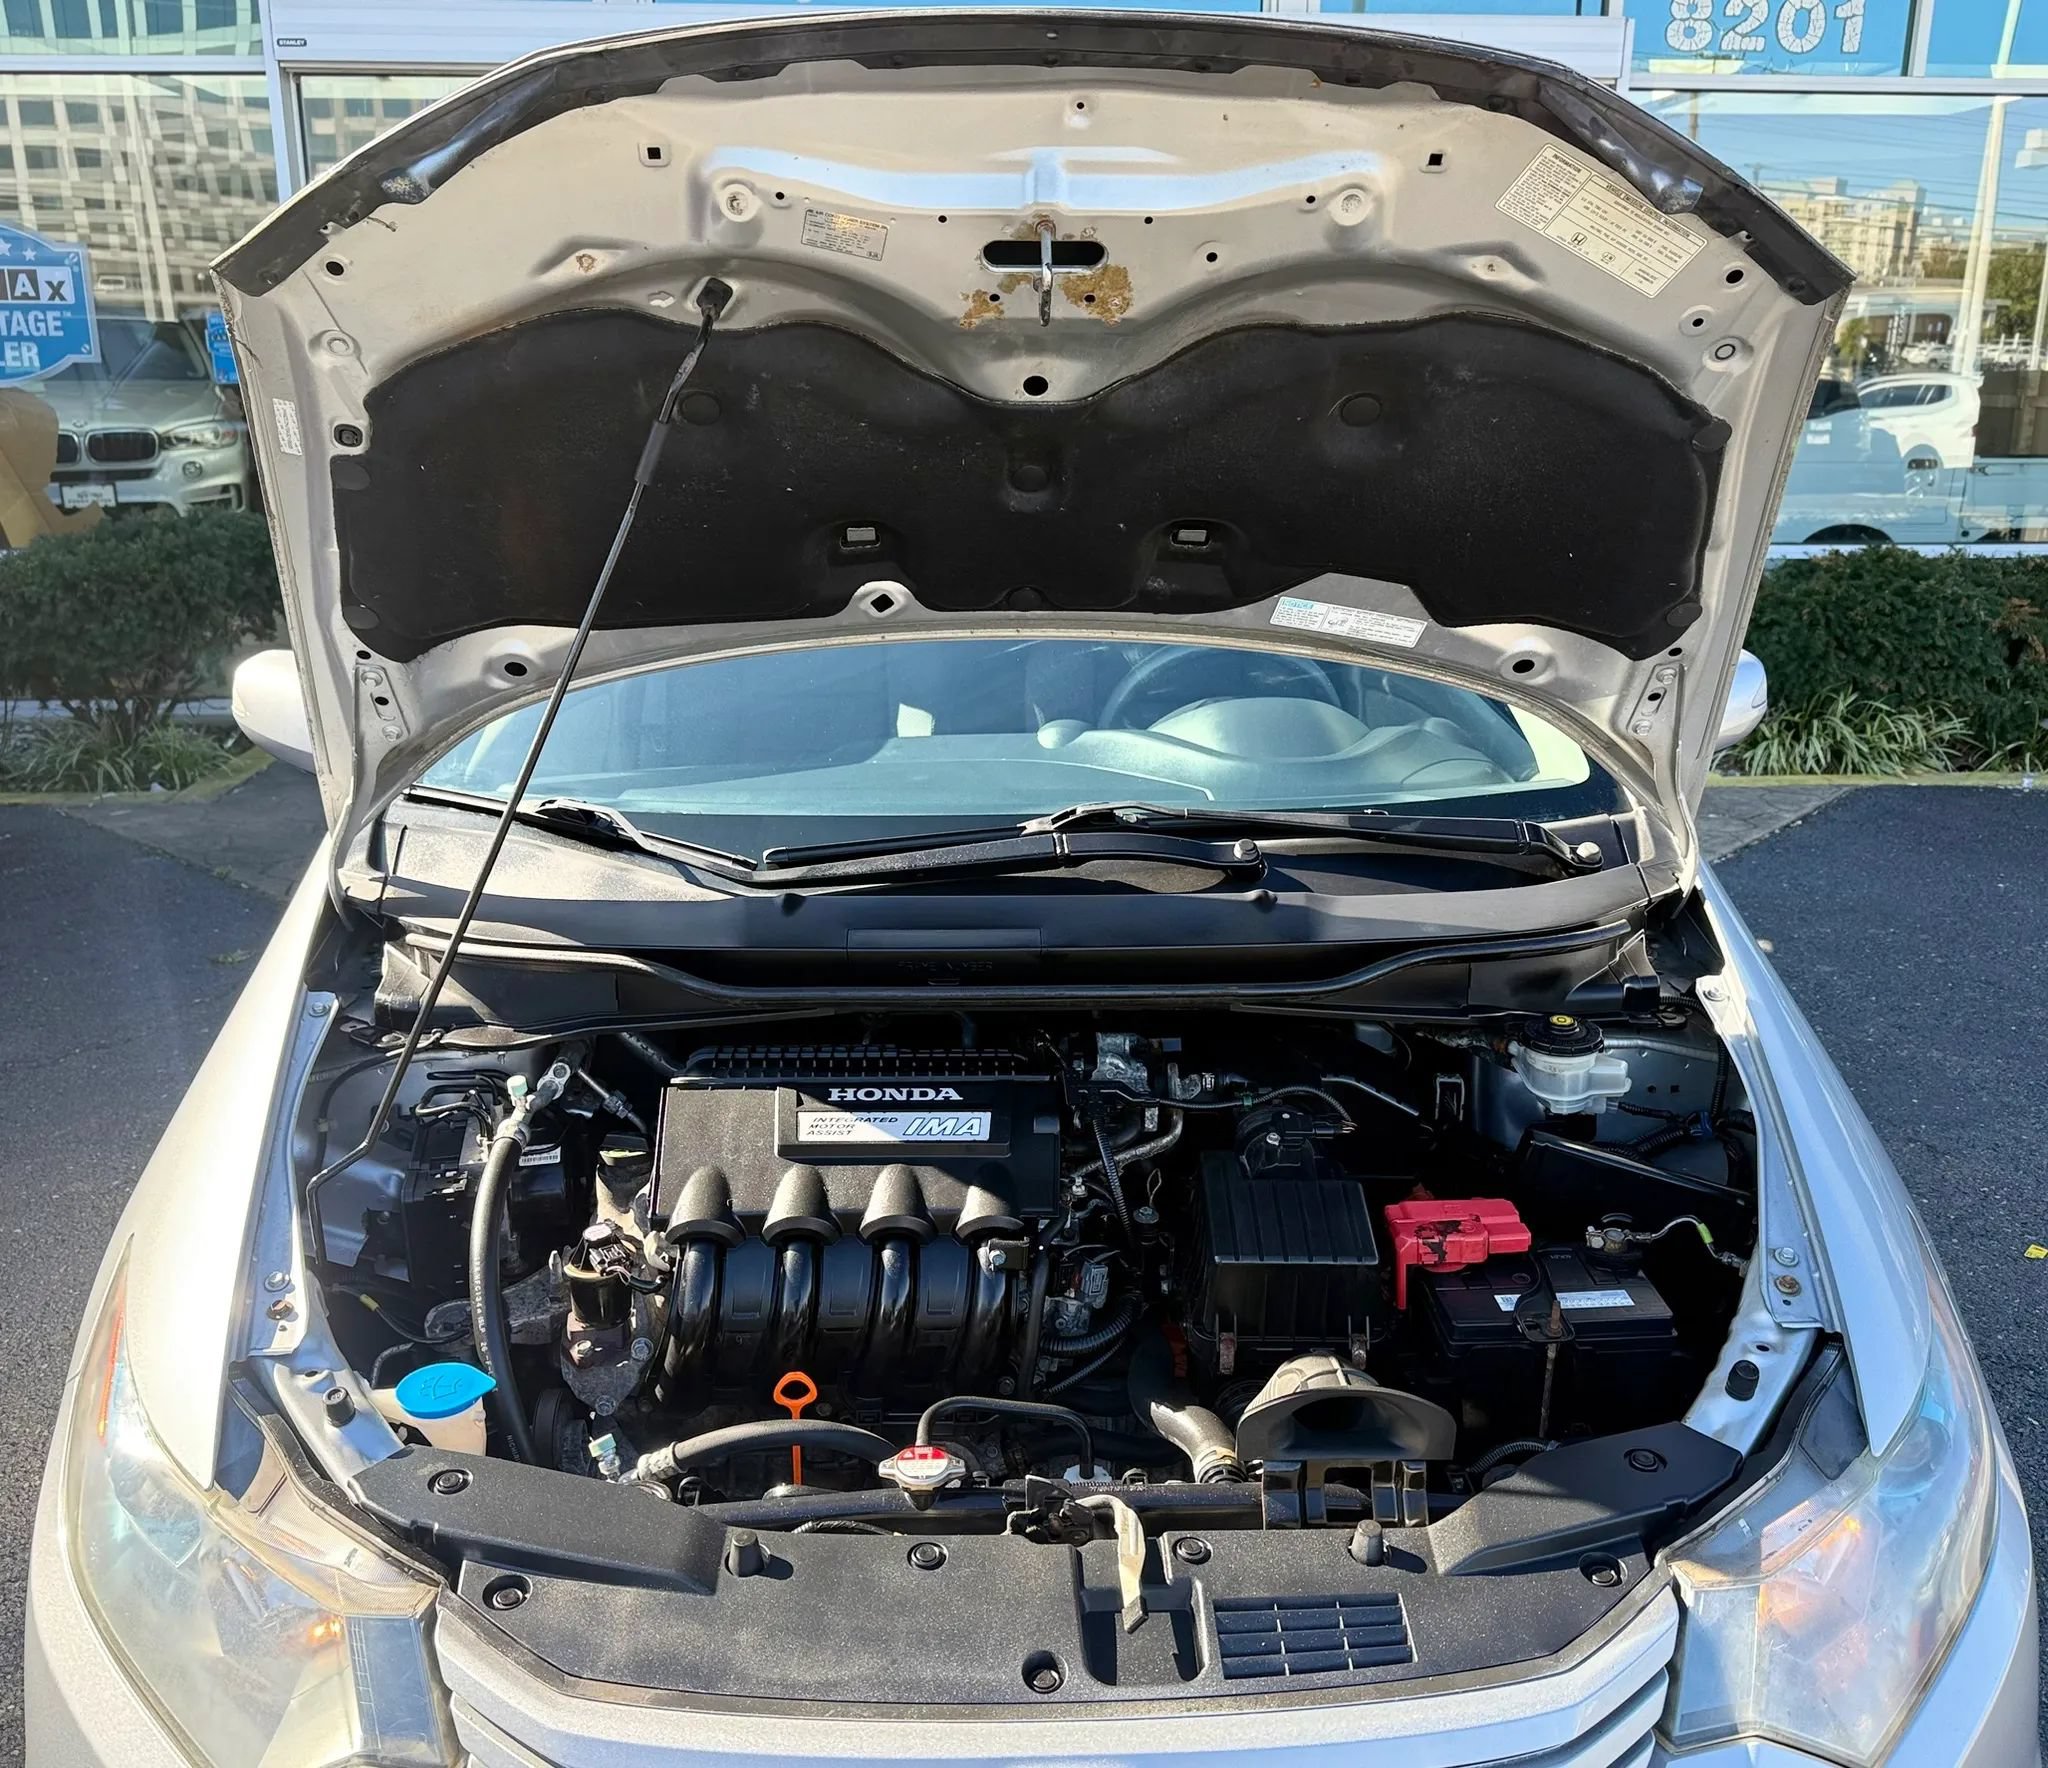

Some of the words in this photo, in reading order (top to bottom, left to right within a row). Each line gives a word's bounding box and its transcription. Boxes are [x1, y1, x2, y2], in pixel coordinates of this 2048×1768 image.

[1665, 0, 1866, 54] 8201
[0, 341, 40, 367] ER
[827, 1087, 963, 1101] HONDA
[903, 1117, 982, 1136] IMA
